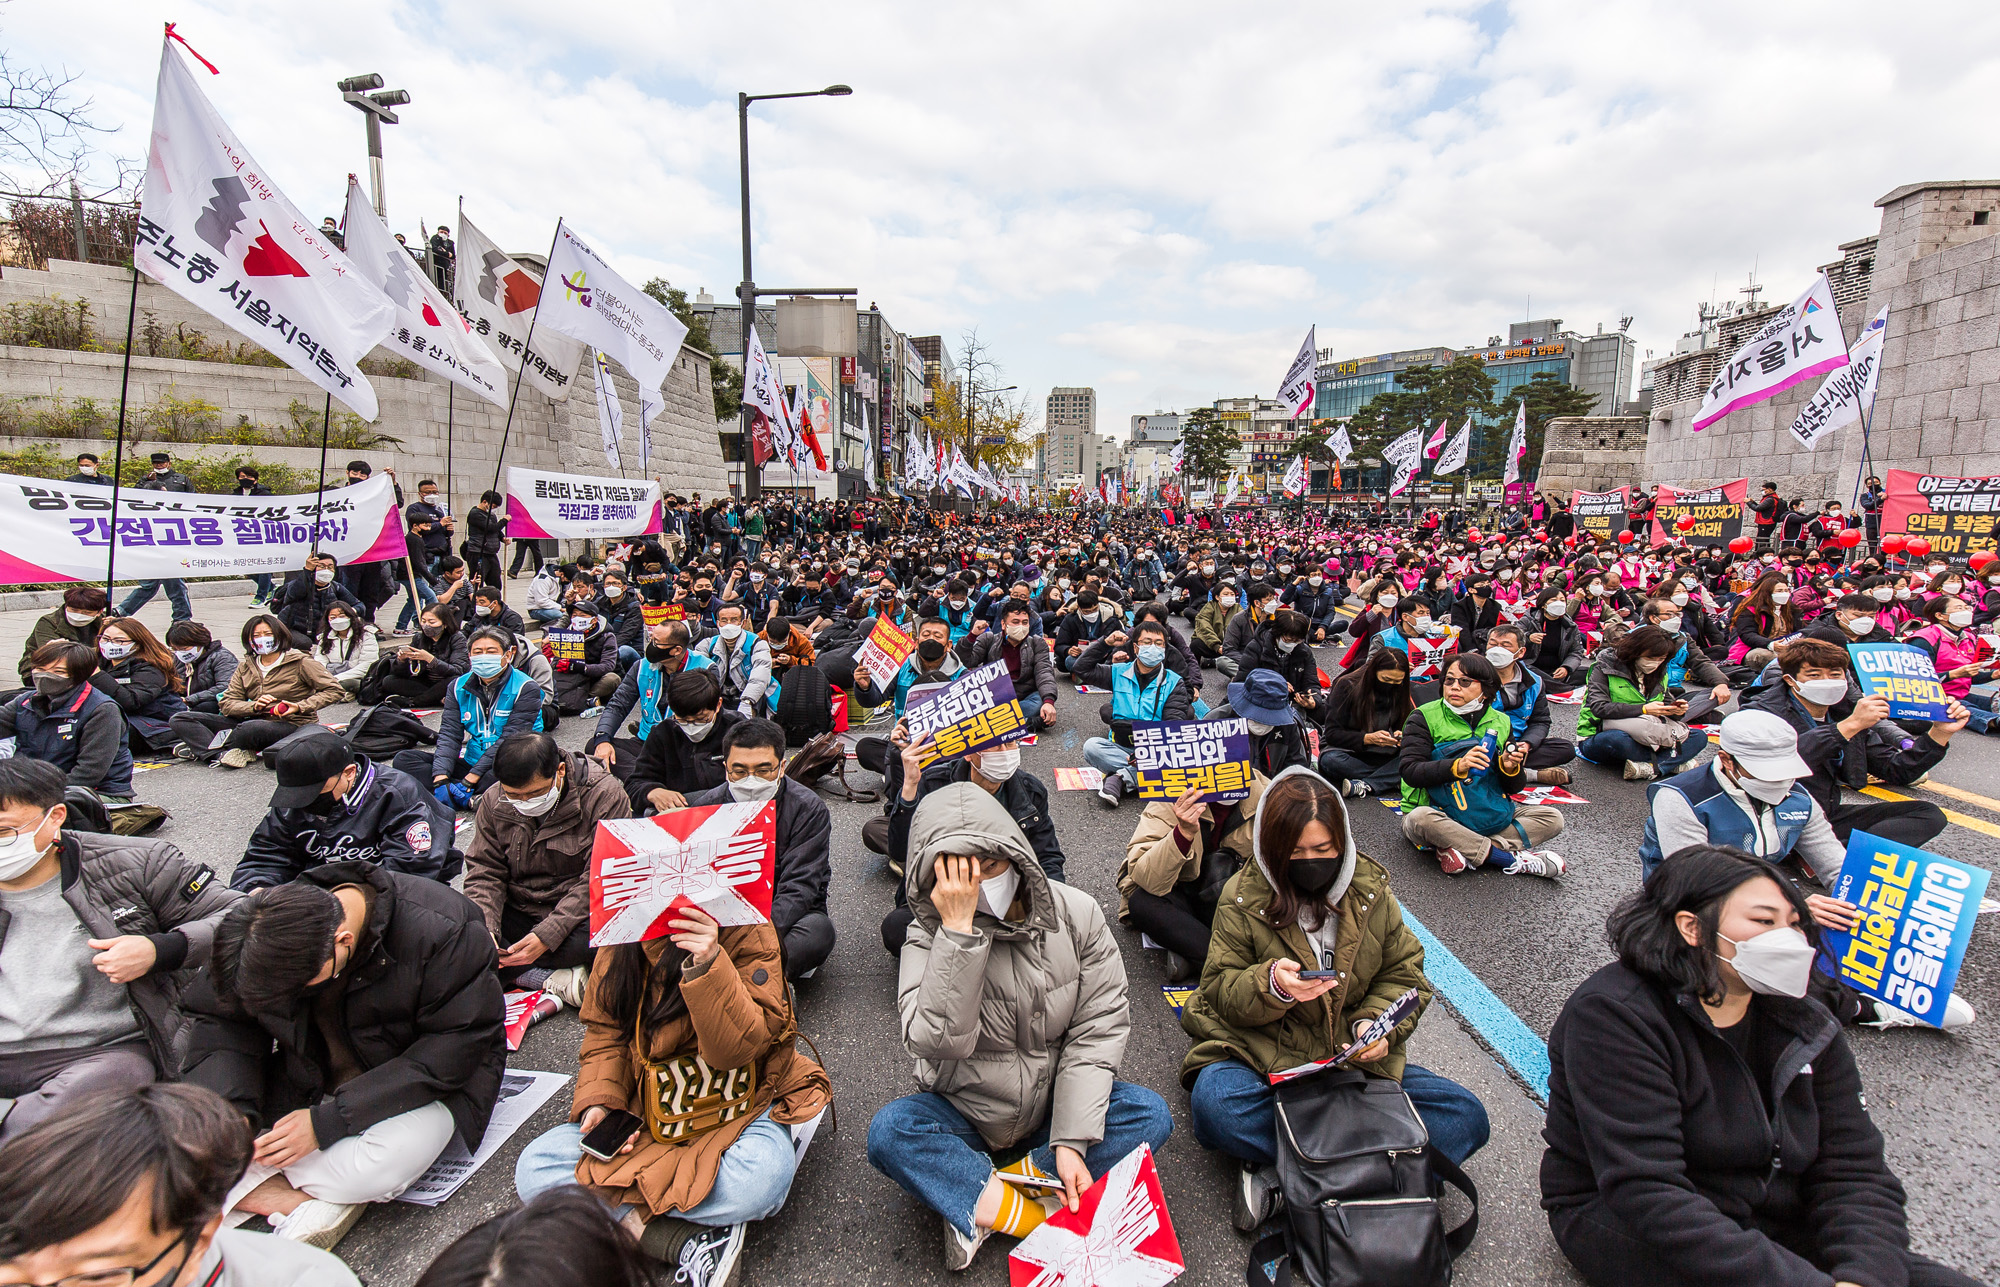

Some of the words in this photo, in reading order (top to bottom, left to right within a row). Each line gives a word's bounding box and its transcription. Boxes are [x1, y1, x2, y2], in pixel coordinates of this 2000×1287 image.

[595, 287, 645, 328] 더불어사는
[219, 279, 355, 388] 서울지역본부
[595, 302, 665, 362] 희망연대노동조합
[1537, 344, 1564, 355] 입원실
[1338, 361, 1358, 376] 치과
[535, 479, 571, 500] 콜센터
[573, 483, 602, 501] 노동자
[604, 486, 630, 501] 저임금
[1917, 476, 1982, 492] 어르신
[558, 503, 600, 521] 직접고용
[602, 504, 637, 520] 쟁취하자!
[1692, 503, 1741, 519] 지자체가
[1908, 514, 1948, 532] 인력
[1953, 514, 2000, 533] 확충
[70, 517, 223, 548] 간접고용
[192, 557, 231, 569] 더불어사는
[233, 556, 286, 568] 희망연대노동조합
[937, 658, 1010, 707] 노동자에게
[906, 700, 936, 724] 모든
[1132, 727, 1163, 747] 모든
[1164, 718, 1249, 745] 노동자에게
[1134, 739, 1228, 771] 일자리와
[1136, 760, 1251, 799] 노동권을!
[1841, 852, 1918, 991] 규탄한다!
[1884, 862, 1971, 1014] CJ대한통운
